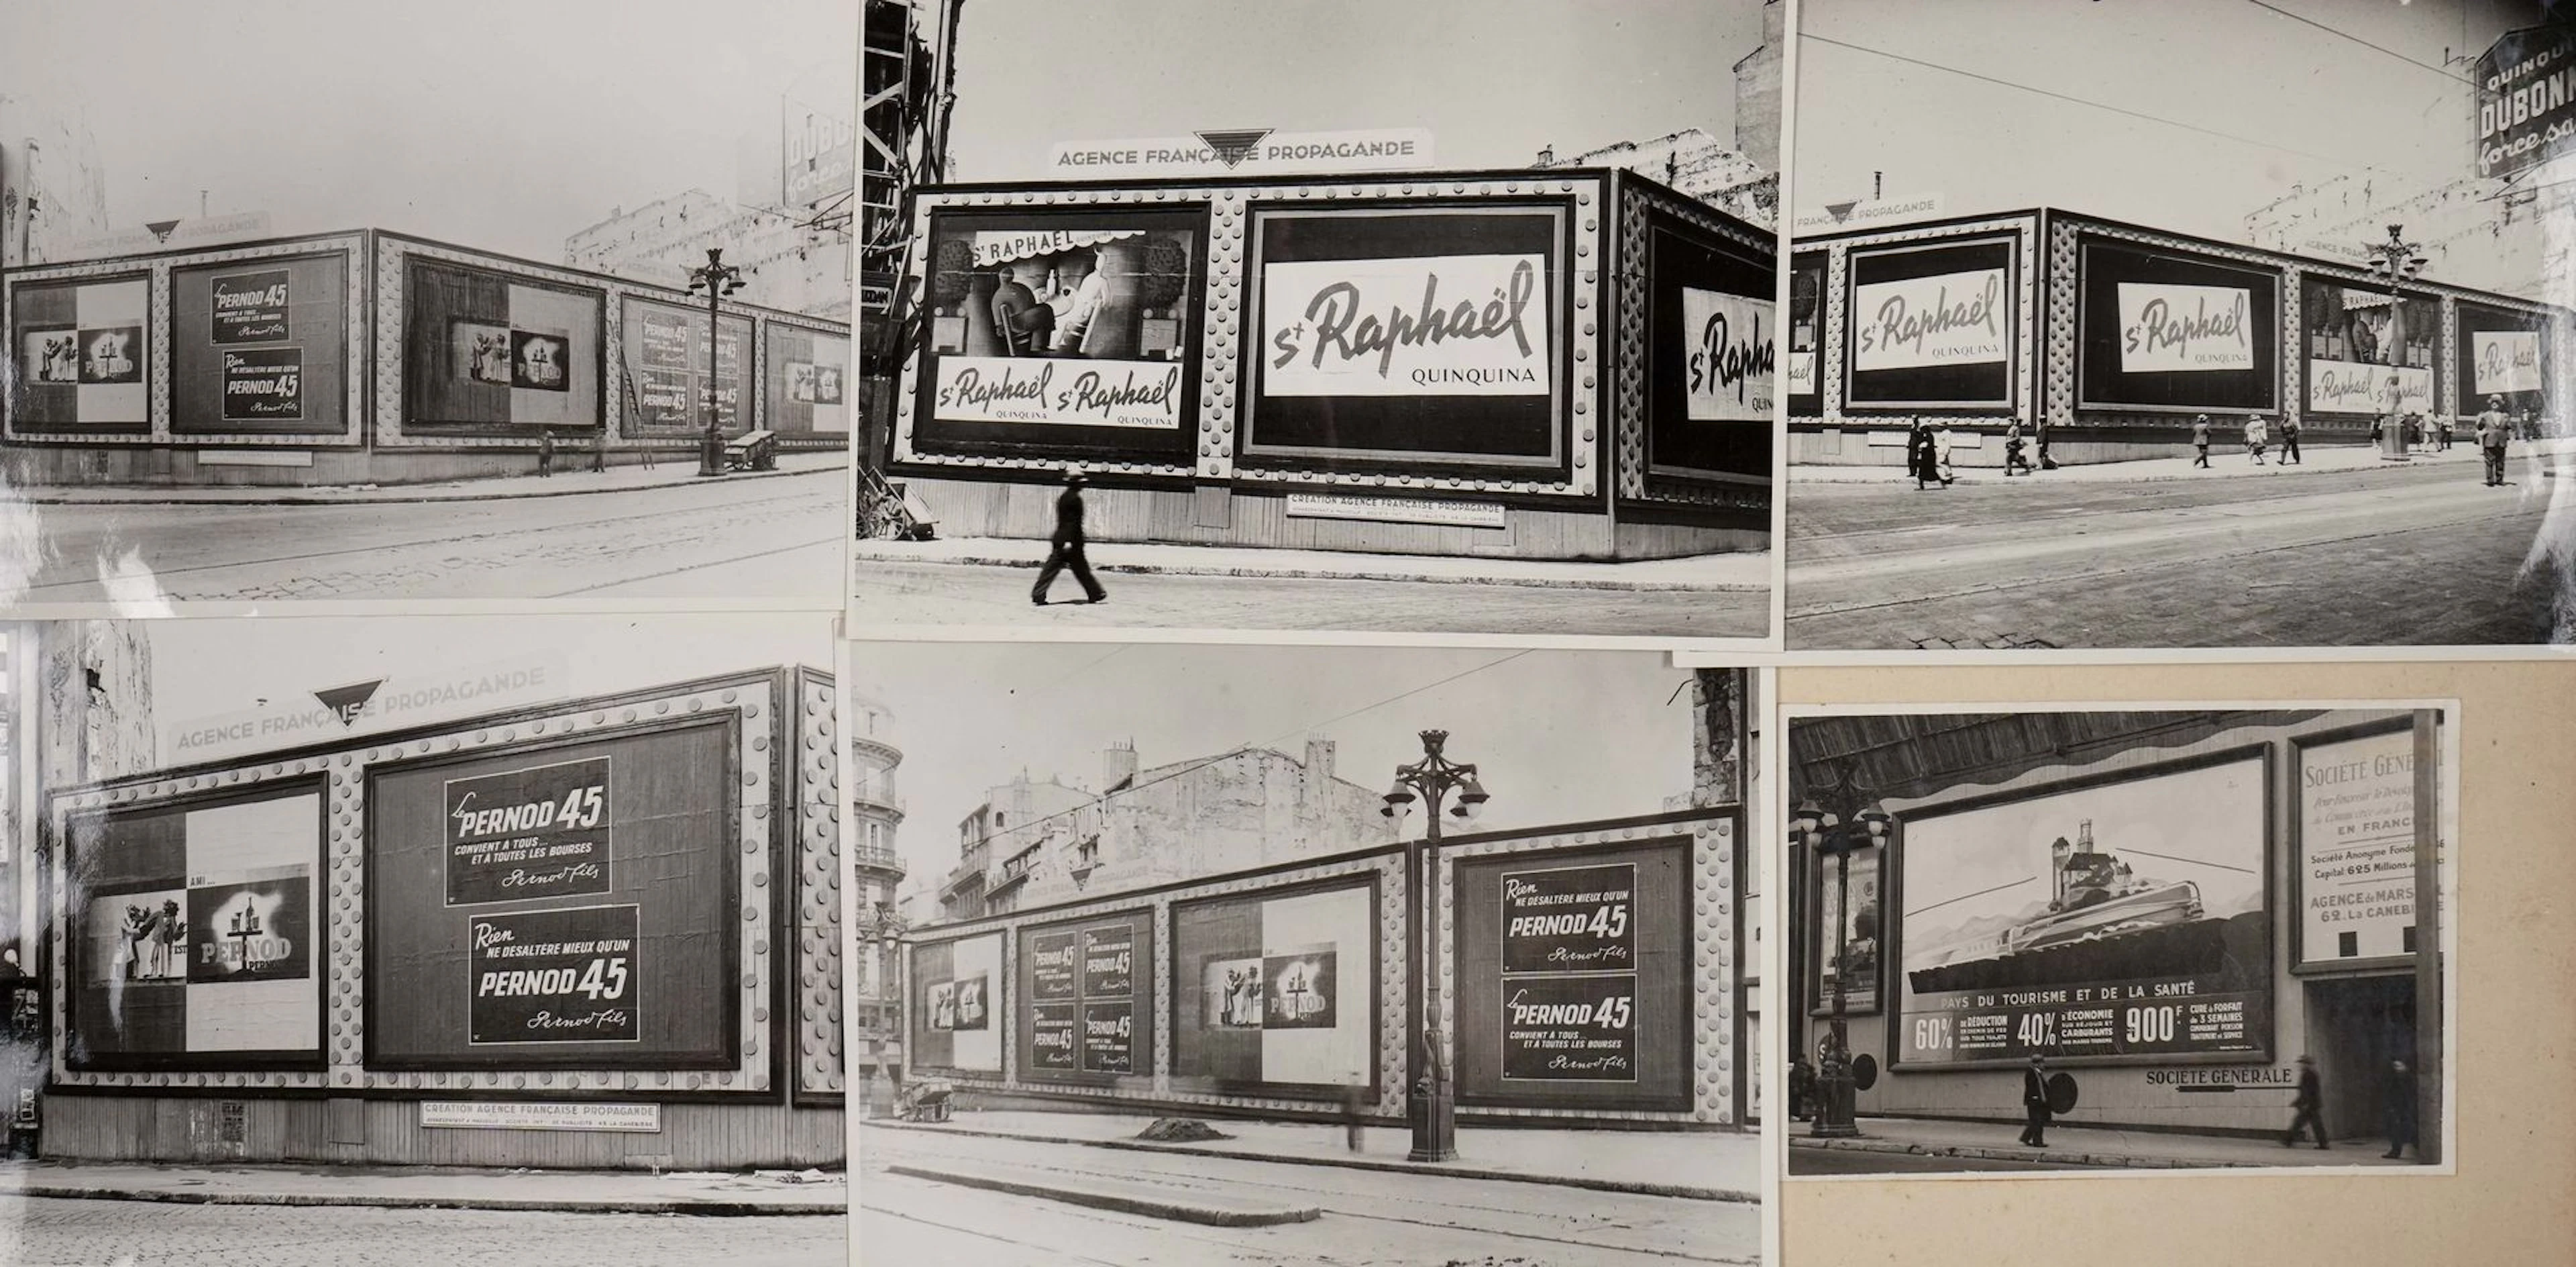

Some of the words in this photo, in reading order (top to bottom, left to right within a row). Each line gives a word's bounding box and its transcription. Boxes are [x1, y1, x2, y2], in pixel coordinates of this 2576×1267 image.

[1058, 151, 1137, 166] AGENCE
[1268, 141, 1414, 160] PROPAGANDE
[2479, 133, 2540, 176] force
[1859, 200, 1935, 219] PROPAGANDE
[218, 291, 264, 308] PERNOD
[264, 284, 286, 307] 45
[1305, 258, 1534, 380] Raphaël
[1877, 273, 1997, 354] Raphaël
[675, 325, 688, 343] 45
[2141, 292, 2245, 358] Raphaël
[1933, 345, 1998, 357] QUINQUINA
[227, 381, 274, 395] PERNOD
[274, 375, 298, 397] 45
[955, 361, 1053, 413] Raphaël
[1412, 368, 1536, 387] QUINQUINA
[672, 393, 686, 410] 45
[727, 387, 737, 404] 45
[1074, 366, 1177, 418] Raphaël
[996, 411, 1047, 419] QUINQUINA
[1118, 415, 1172, 426] QUINQUINA
[1342, 497, 1377, 507] AGENCE
[1438, 502, 1499, 513] PROPAGANDE
[178, 721, 254, 750] AGENCE
[385, 666, 545, 715] PROPAGANDE
[459, 801, 555, 838] PERNOD
[556, 785, 604, 829] 45
[2338, 825, 2355, 835] EN
[2363, 817, 2415, 832] FRANC
[454, 842, 501, 856] CONVIENT
[472, 854, 483, 865] ET
[494, 850, 527, 863] TOUTES
[529, 848, 547, 859] LES
[549, 842, 593, 857] BOURSES
[2311, 853, 2343, 864] Société
[2346, 849, 2386, 861] Anonyme
[502, 866, 568, 888] Pernod
[565, 862, 599, 883] fils
[2315, 867, 2344, 880] Capital
[2348, 864, 2371, 874] 625
[2374, 862, 2407, 872] Millions
[1505, 878, 1538, 901] Rien
[1515, 897, 1526, 907] NE
[1576, 892, 1601, 903] MIEUX
[1603, 891, 1629, 901] QU'UN
[2310, 893, 2364, 909] AGENCE
[2365, 893, 2375, 903] de
[1509, 913, 1588, 937] PERNOD
[1587, 905, 1627, 938] 45
[2348, 911, 2363, 919] La
[475, 923, 515, 950] Rien
[202, 937, 291, 964] PERNOD
[486, 947, 501, 959] NE
[561, 941, 594, 954] MIEUX
[596, 939, 631, 953] QU'UN
[1062, 946, 1074, 966] 45
[1548, 947, 1603, 962] Pernod
[1600, 945, 1627, 961] fils
[1115, 952, 1130, 974] 45
[478, 968, 577, 997] PERNOD
[576, 958, 628, 1000] 45
[1941, 997, 1969, 1008] PAYS
[1978, 995, 1994, 1006] DU
[2002, 990, 2067, 1005] TOURISME
[2076, 989, 2091, 1001] ET
[2101, 987, 2118, 999] DE
[2128, 986, 2145, 998] LA
[2154, 980, 2195, 997] SANTÉ
[1513, 1005, 1593, 1025] PERNOD
[1593, 997, 1631, 1029] 45
[2200, 1015, 2206, 1023] 3
[2208, 1012, 2243, 1023] SEMAINES
[2213, 1002, 2243, 1013] FORFAIT
[527, 1010, 596, 1029] Pernod
[594, 1009, 627, 1029] fils
[1086, 1021, 1117, 1035] PERNOD
[1116, 1015, 1130, 1037] 45
[1059, 1029, 1073, 1050] 45
[1509, 1031, 1547, 1040] CONVIENT
[1915, 1017, 1953, 1049] 60%
[2017, 1012, 2056, 1047] 40%
[2061, 1028, 2113, 1037] CARBURANTS
[1523, 1040, 1532, 1048] ET
[1542, 1040, 1568, 1048] TOUTES
[1571, 1040, 1585, 1048] LES
[1587, 1040, 1622, 1048] BOURSES
[1548, 1055, 1603, 1069] Pernod
[1600, 1056, 1627, 1070] fils
[477, 1105, 516, 1114] AGENCE
[583, 1107, 655, 1116] PROPAGANDE
